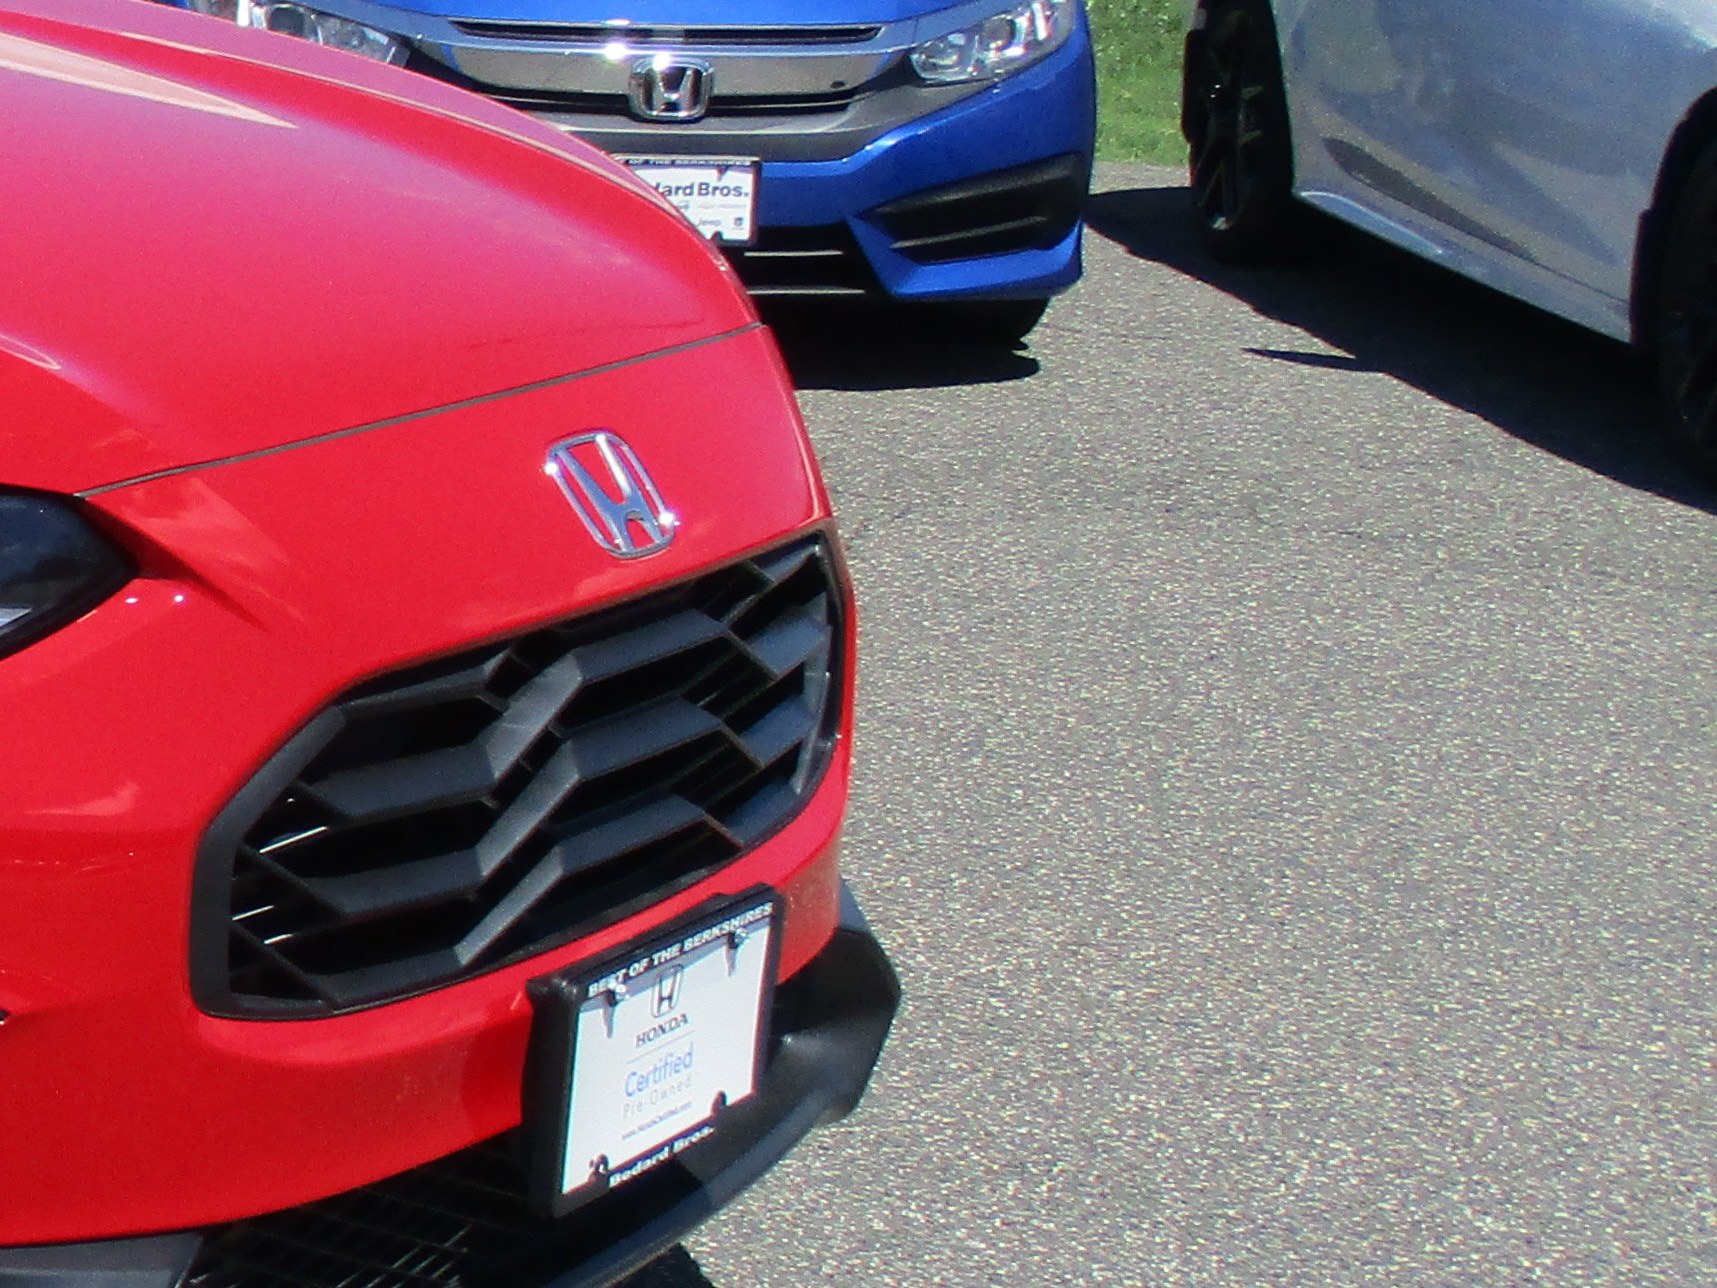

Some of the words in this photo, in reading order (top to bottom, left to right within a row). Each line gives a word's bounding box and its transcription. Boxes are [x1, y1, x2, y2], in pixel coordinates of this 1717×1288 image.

[698, 182, 750, 198] Bros.
[628, 958, 651, 977] OF
[652, 942, 682, 966] THE
[683, 902, 774, 952] BERKSHIRES
[635, 1013, 689, 1048] HONDA
[624, 1042, 694, 1098] Certified
[622, 1077, 692, 1118] Pre-Owned
[608, 1146, 670, 1188] Bedard
[672, 1126, 716, 1154] Bros.
